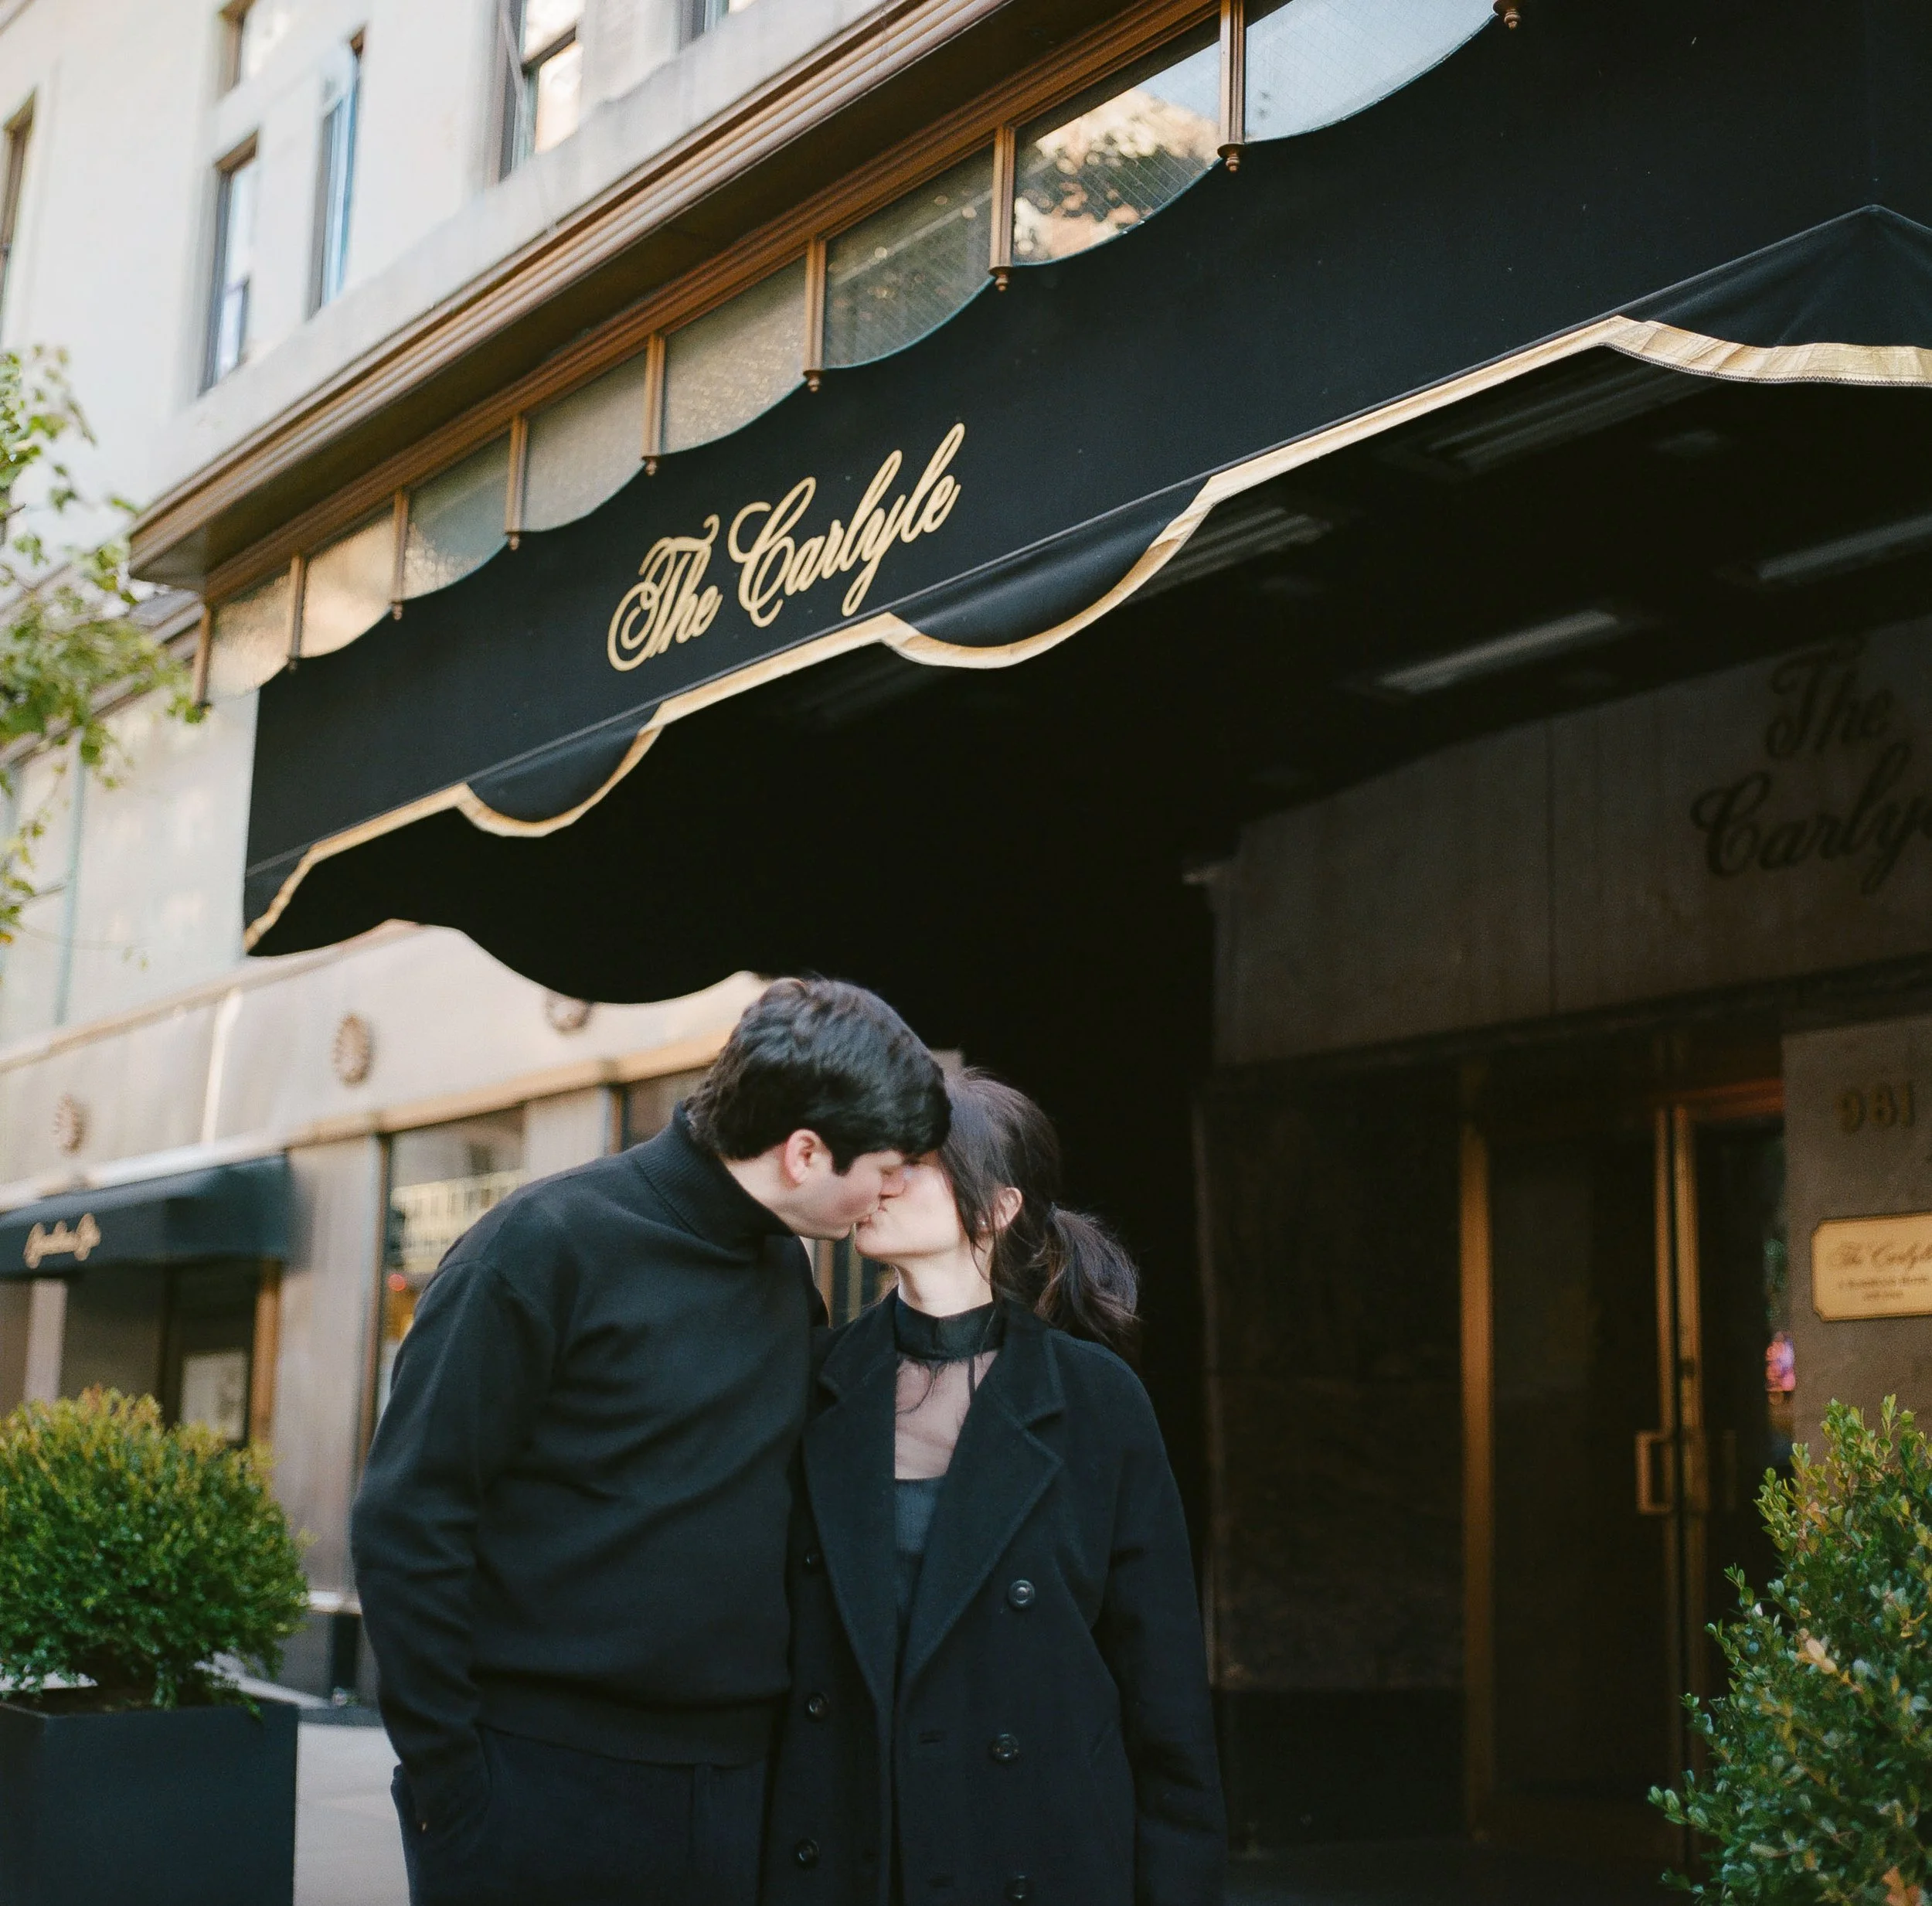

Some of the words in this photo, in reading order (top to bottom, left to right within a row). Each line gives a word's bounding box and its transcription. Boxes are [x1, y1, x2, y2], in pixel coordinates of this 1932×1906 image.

[607, 513, 723, 672] The
[727, 422, 965, 628] Carlyle
[1764, 635, 1893, 761] The
[1689, 740, 1932, 896] Carly
